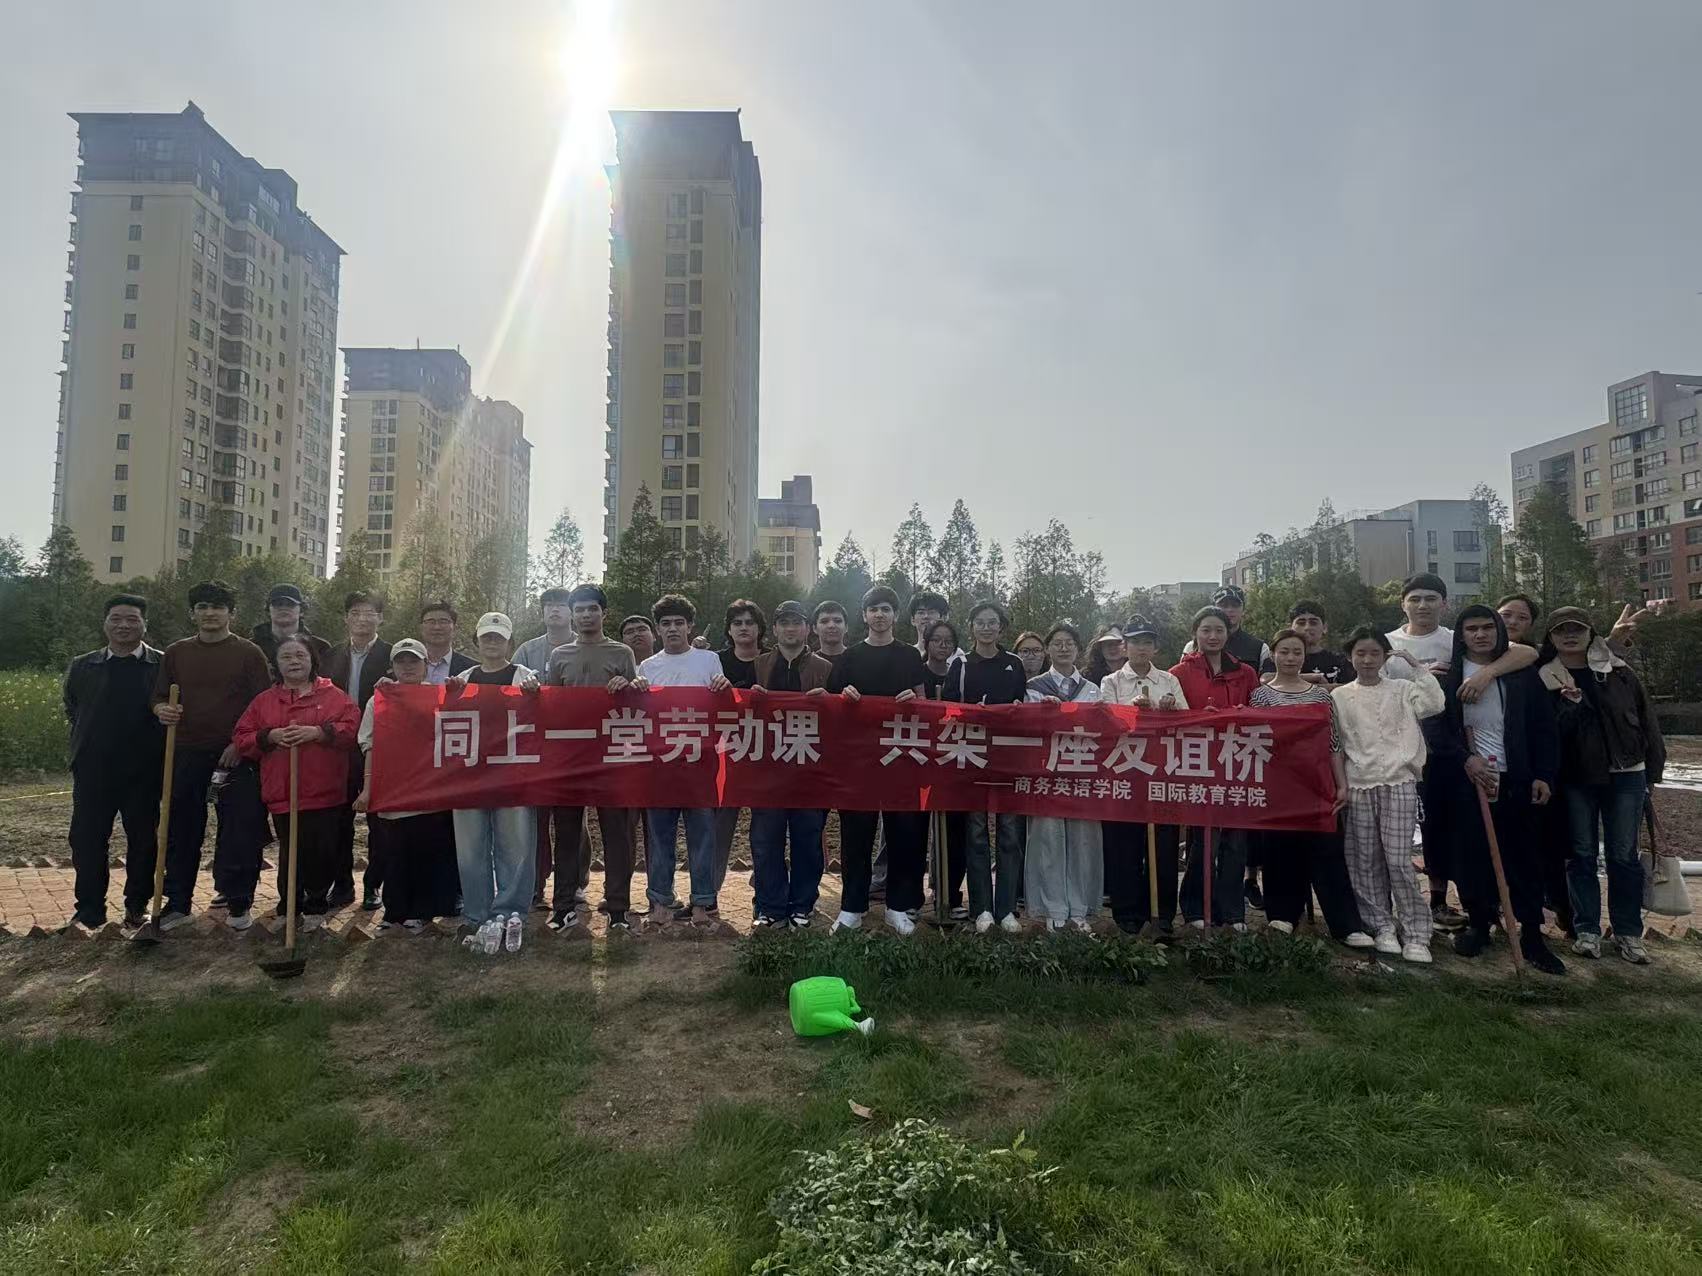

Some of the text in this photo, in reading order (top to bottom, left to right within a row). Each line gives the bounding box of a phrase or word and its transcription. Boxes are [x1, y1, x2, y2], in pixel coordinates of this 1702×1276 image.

[434, 707, 1273, 782] 同上一堂劳动课 共架一座友谊桥
[1148, 781, 1267, 808] 国际教育学院
